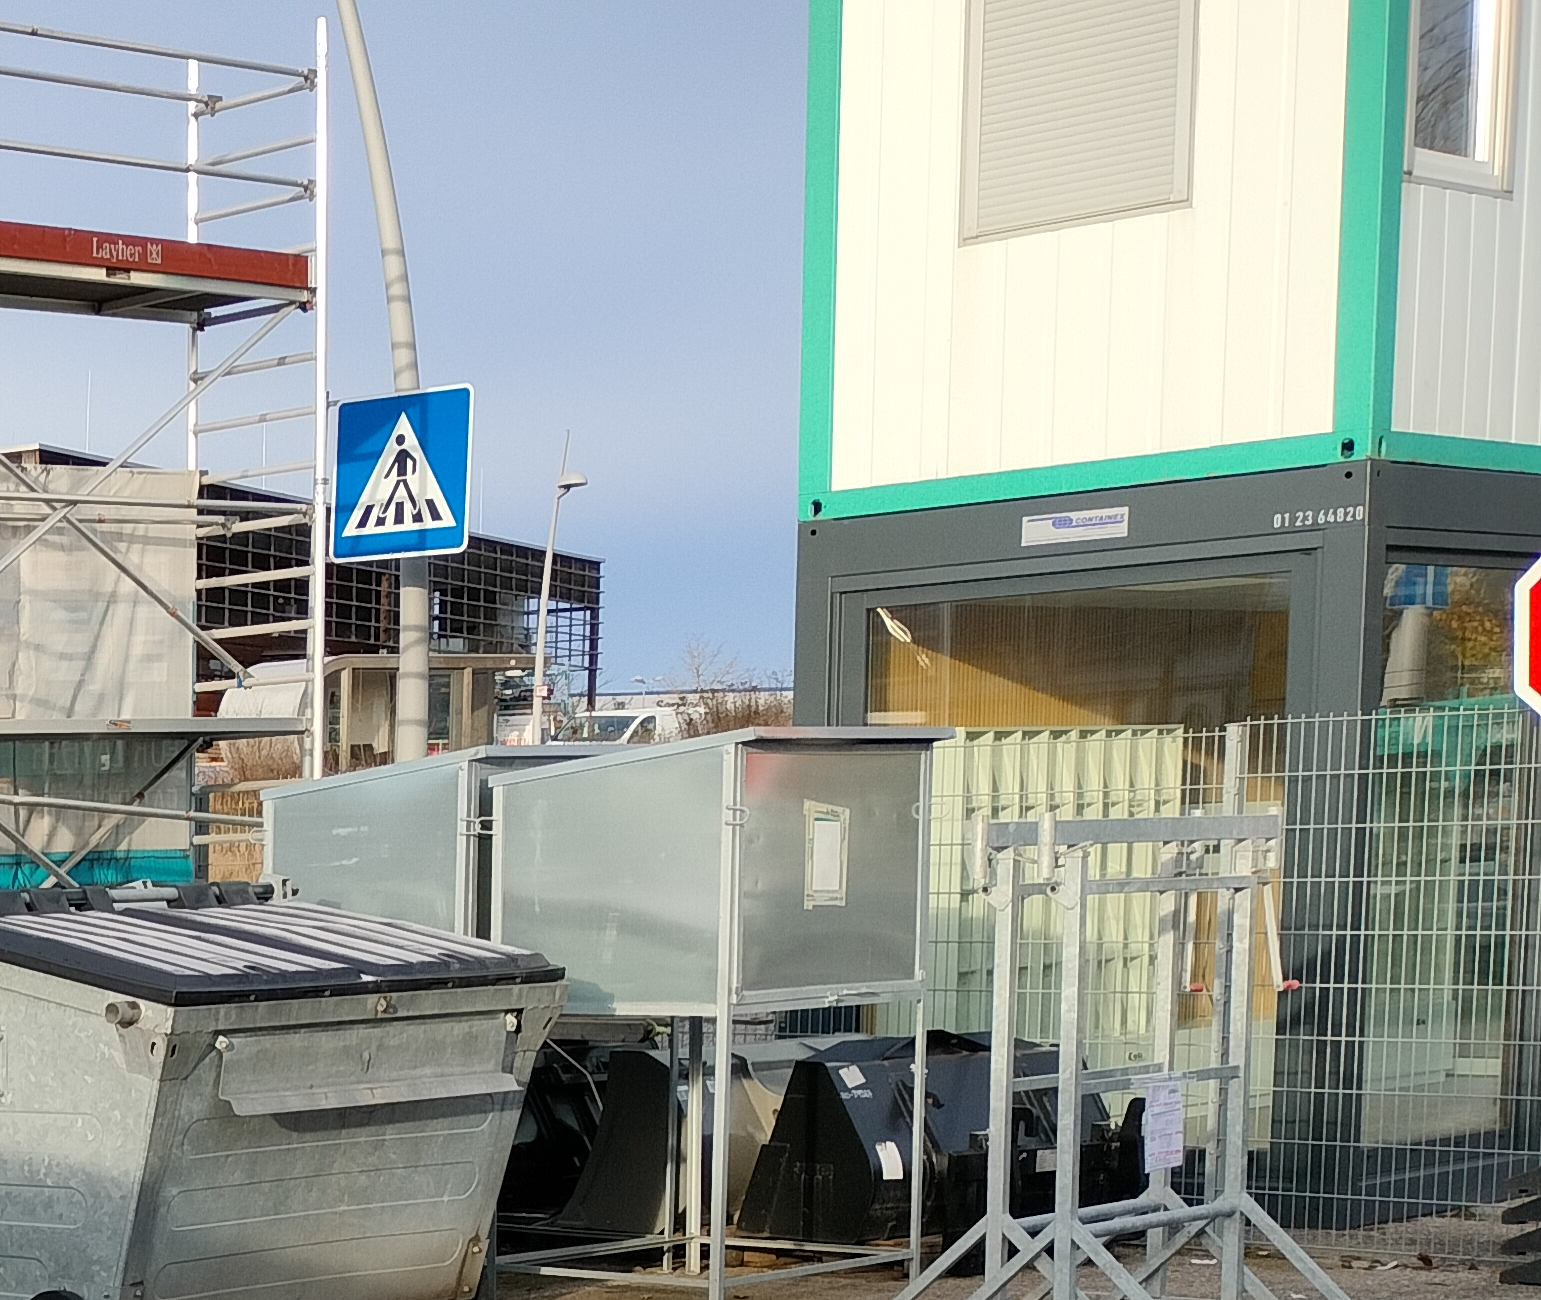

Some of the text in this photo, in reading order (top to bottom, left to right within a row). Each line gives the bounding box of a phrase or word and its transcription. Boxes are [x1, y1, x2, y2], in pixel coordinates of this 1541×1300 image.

[92, 237, 143, 262] Layher
[1273, 505, 1364, 528] 01 23 64820
